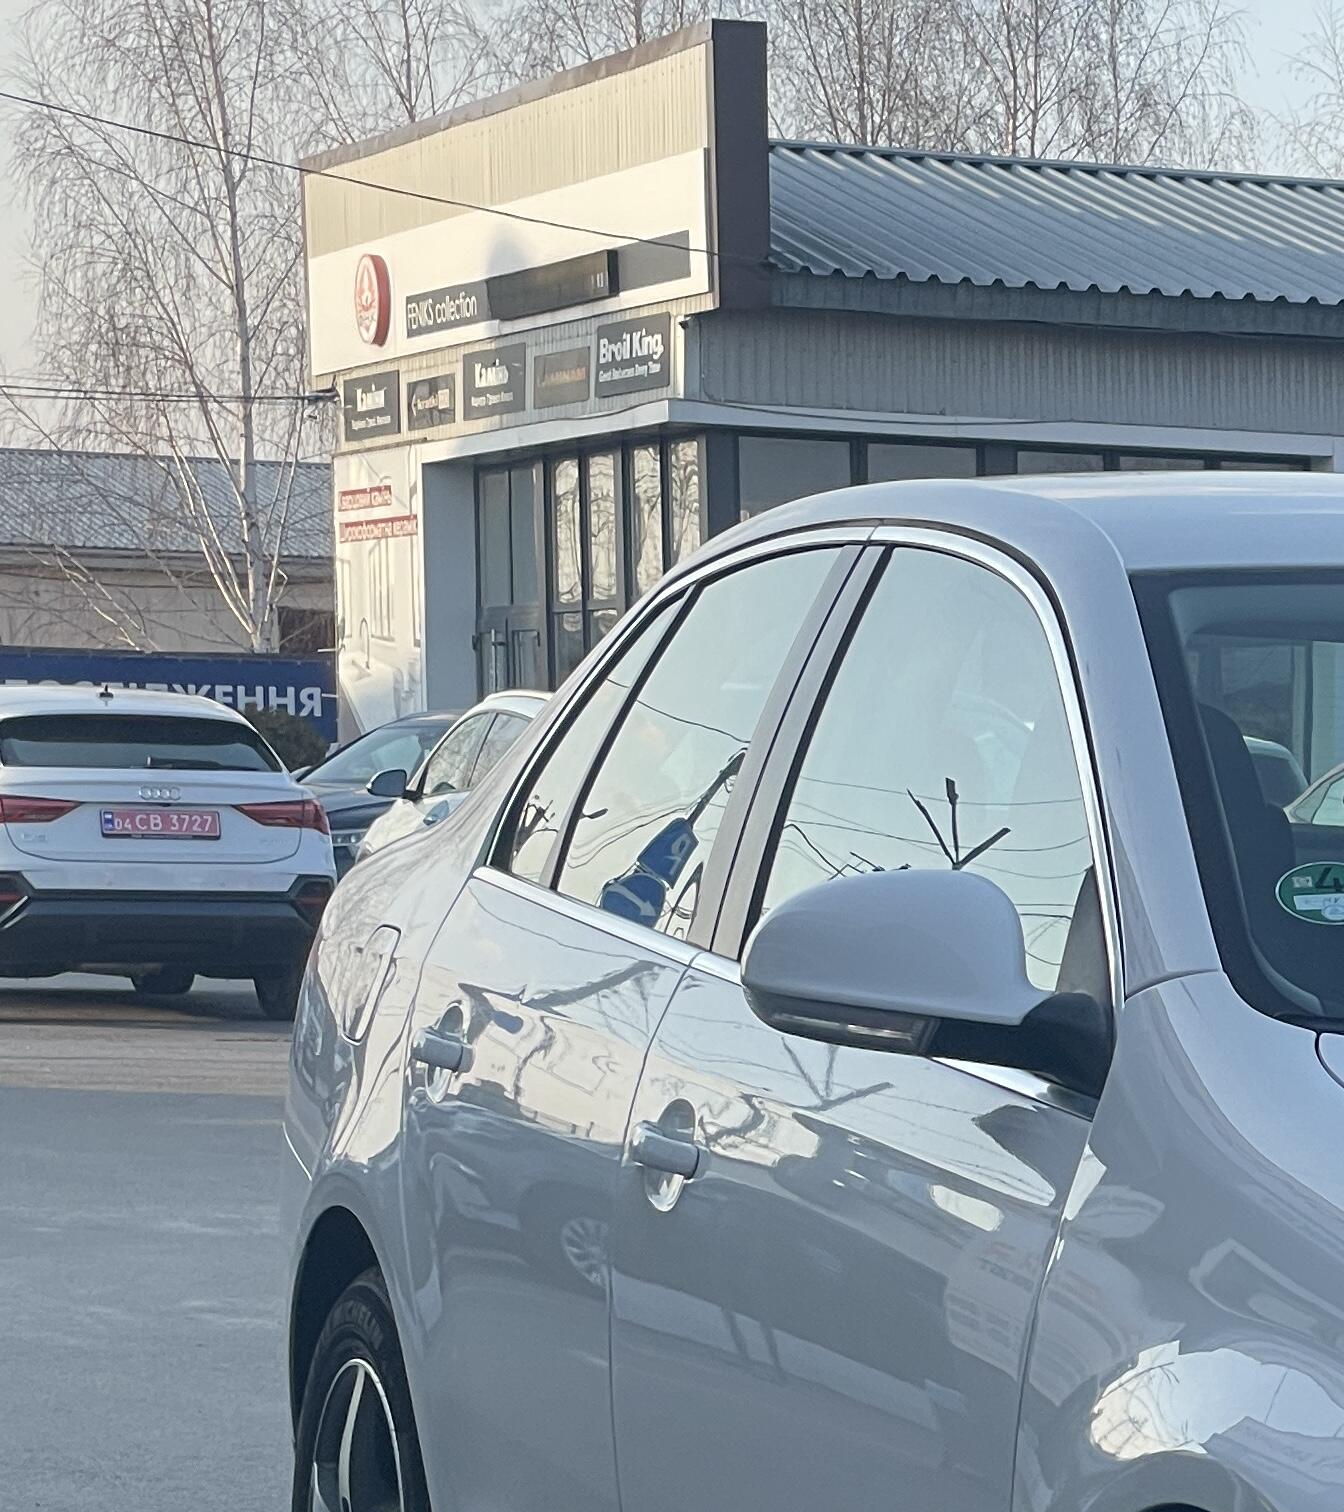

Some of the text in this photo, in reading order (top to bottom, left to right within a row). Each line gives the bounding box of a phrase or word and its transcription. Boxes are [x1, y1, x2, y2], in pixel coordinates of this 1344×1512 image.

[436, 291, 478, 323] collection
[599, 328, 665, 364] Broil King
[115, 818, 132, 830] 04
[169, 814, 212, 832] 3727
